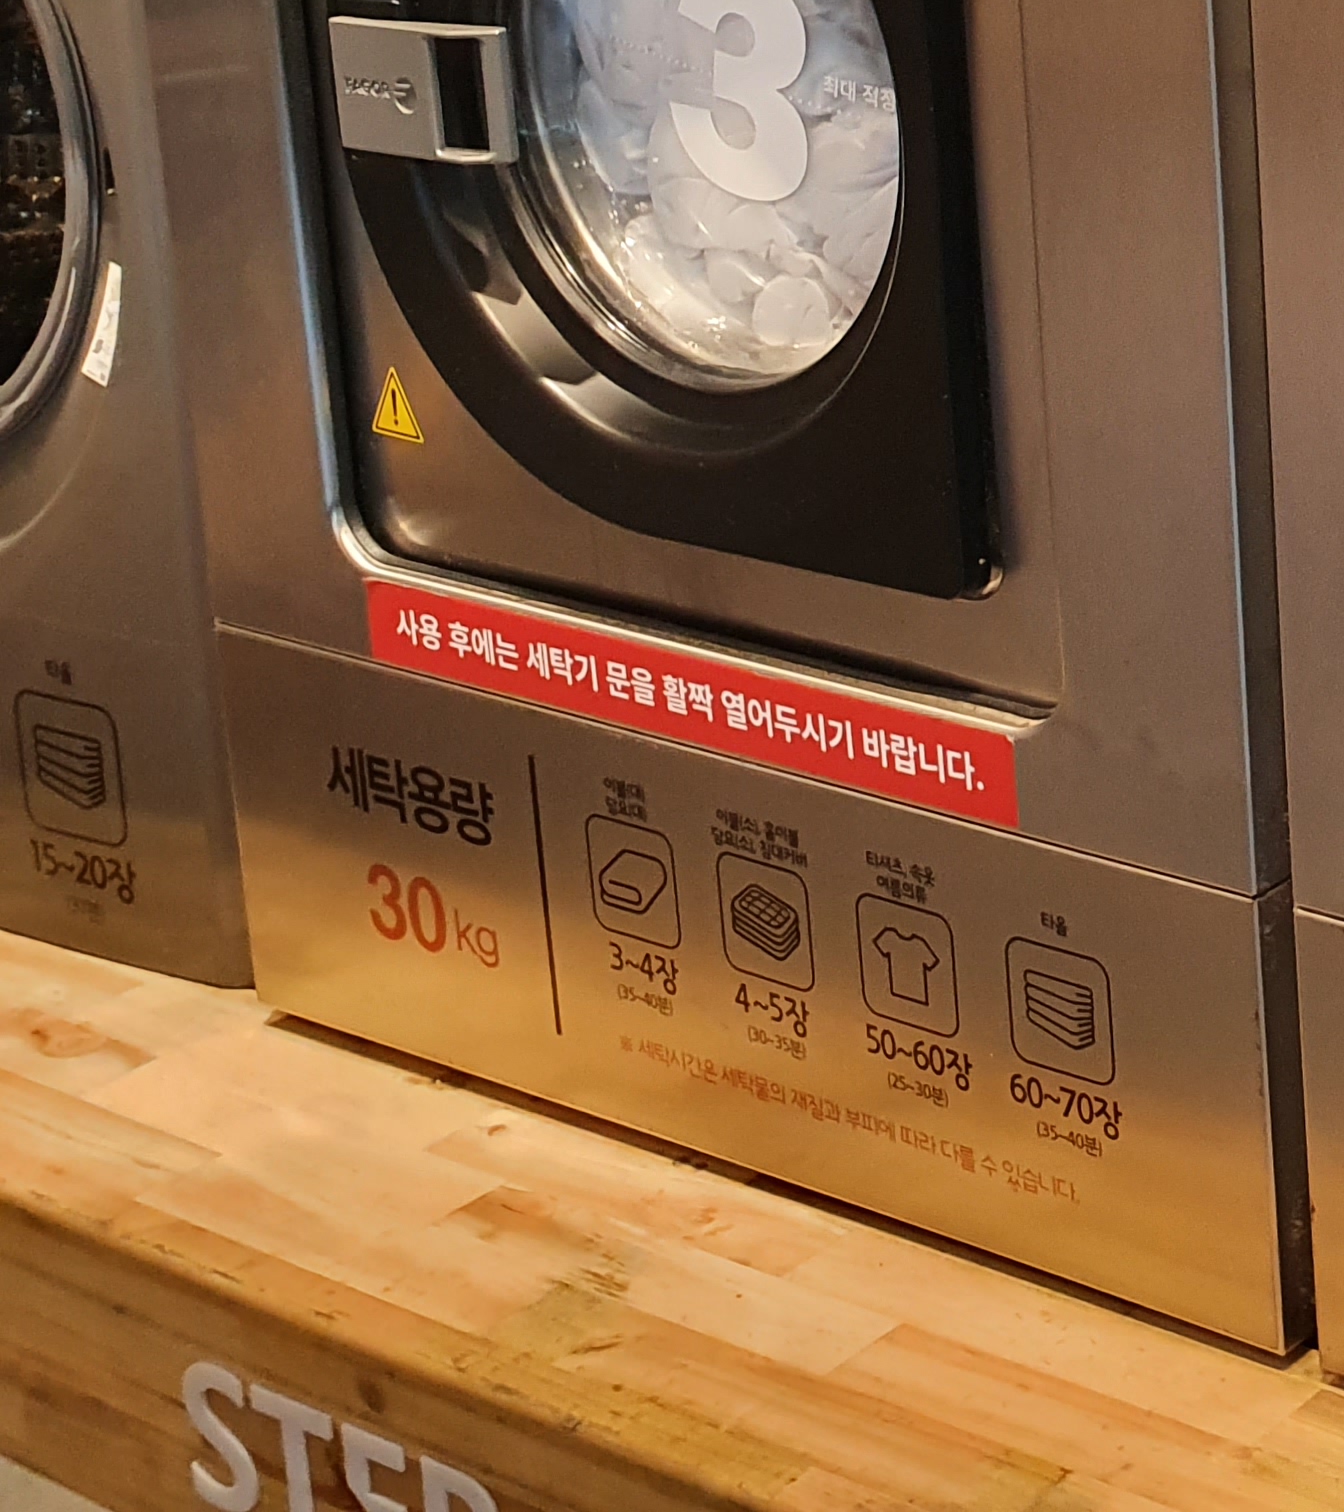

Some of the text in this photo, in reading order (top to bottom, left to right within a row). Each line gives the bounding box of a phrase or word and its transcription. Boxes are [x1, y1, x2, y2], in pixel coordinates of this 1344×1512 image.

[823, 76, 856, 103] 최대
[397, 609, 985, 791] 사용 후에는 세탁기 문을 활짝 열어두시기 바랍니다.
[327, 745, 494, 846] 세탁용량
[367, 863, 446, 953] 30
[608, 942, 679, 996] 3~4장
[734, 983, 810, 1039] 4~5장
[866, 1022, 973, 1092] 50~60장
[1009, 1072, 1123, 1141] 60~70장
